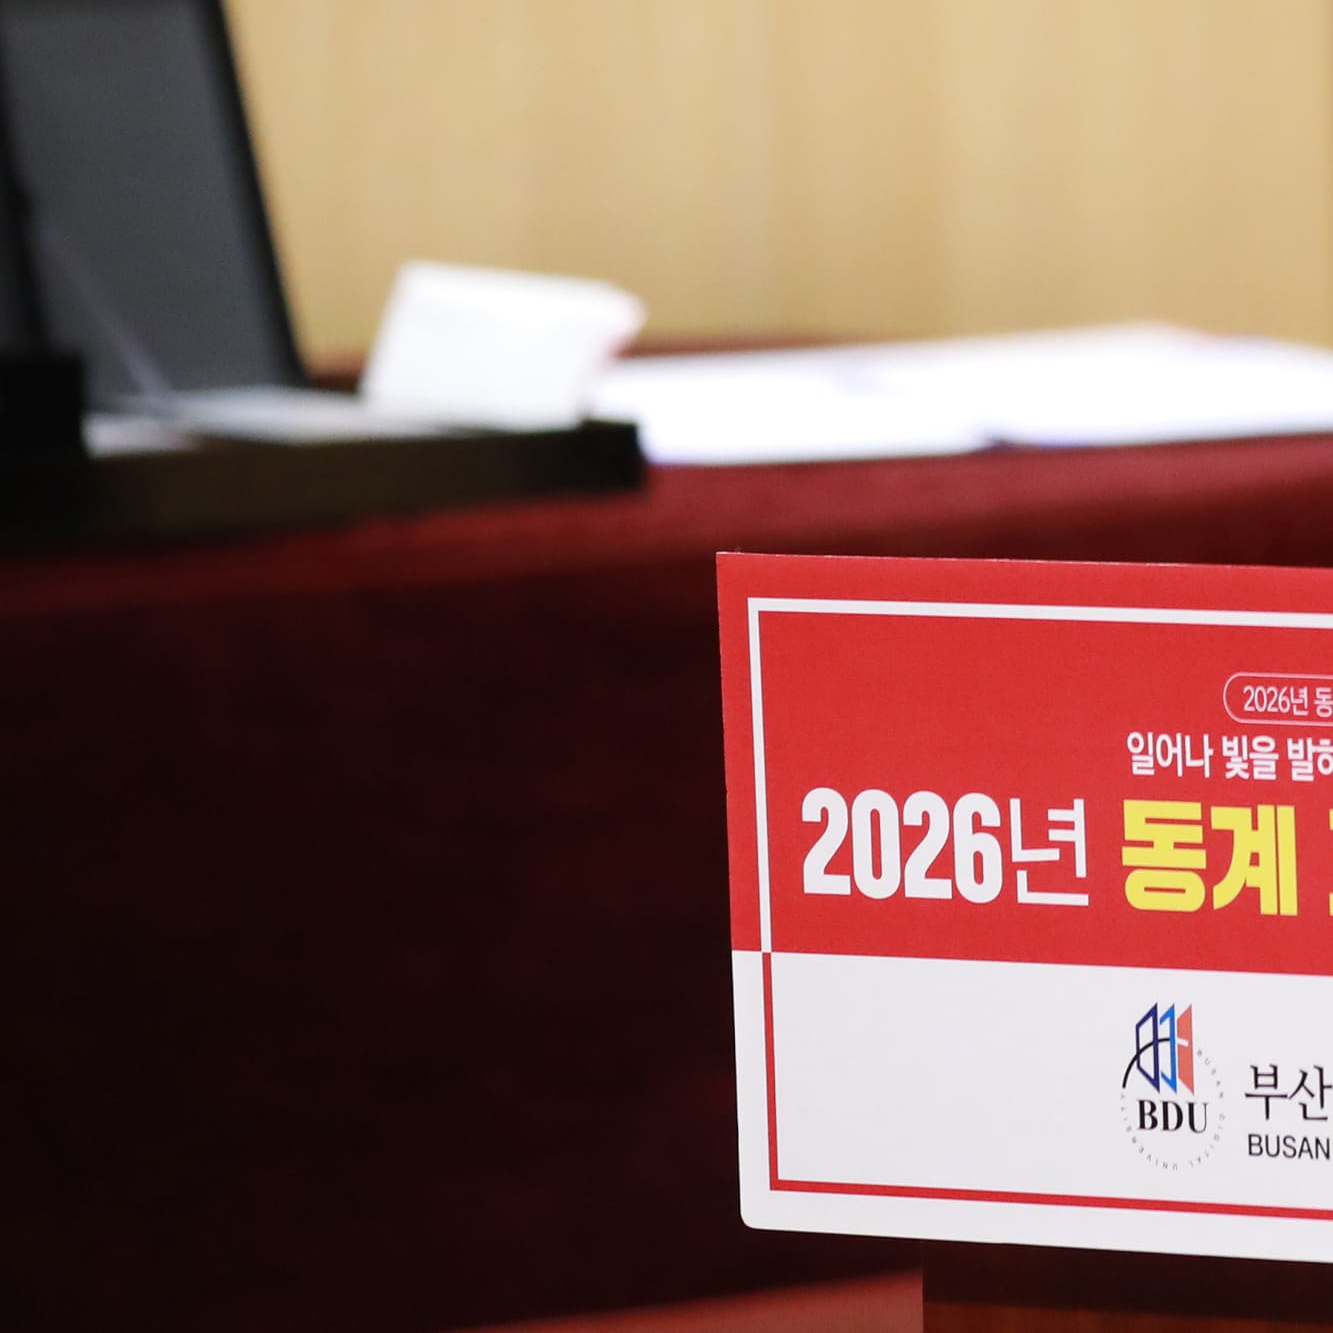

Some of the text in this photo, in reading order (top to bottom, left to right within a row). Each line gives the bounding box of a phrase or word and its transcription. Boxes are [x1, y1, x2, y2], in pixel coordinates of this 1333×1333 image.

[1242, 684, 1310, 717] 2026년
[1126, 731, 1213, 779] 일어나
[1221, 734, 1280, 781] 빛을
[801, 786, 1090, 907] 2026년
[1121, 799, 1299, 917] 동계
[1137, 1099, 1209, 1134] BDU
[1247, 1133, 1331, 1161] BUSAN
